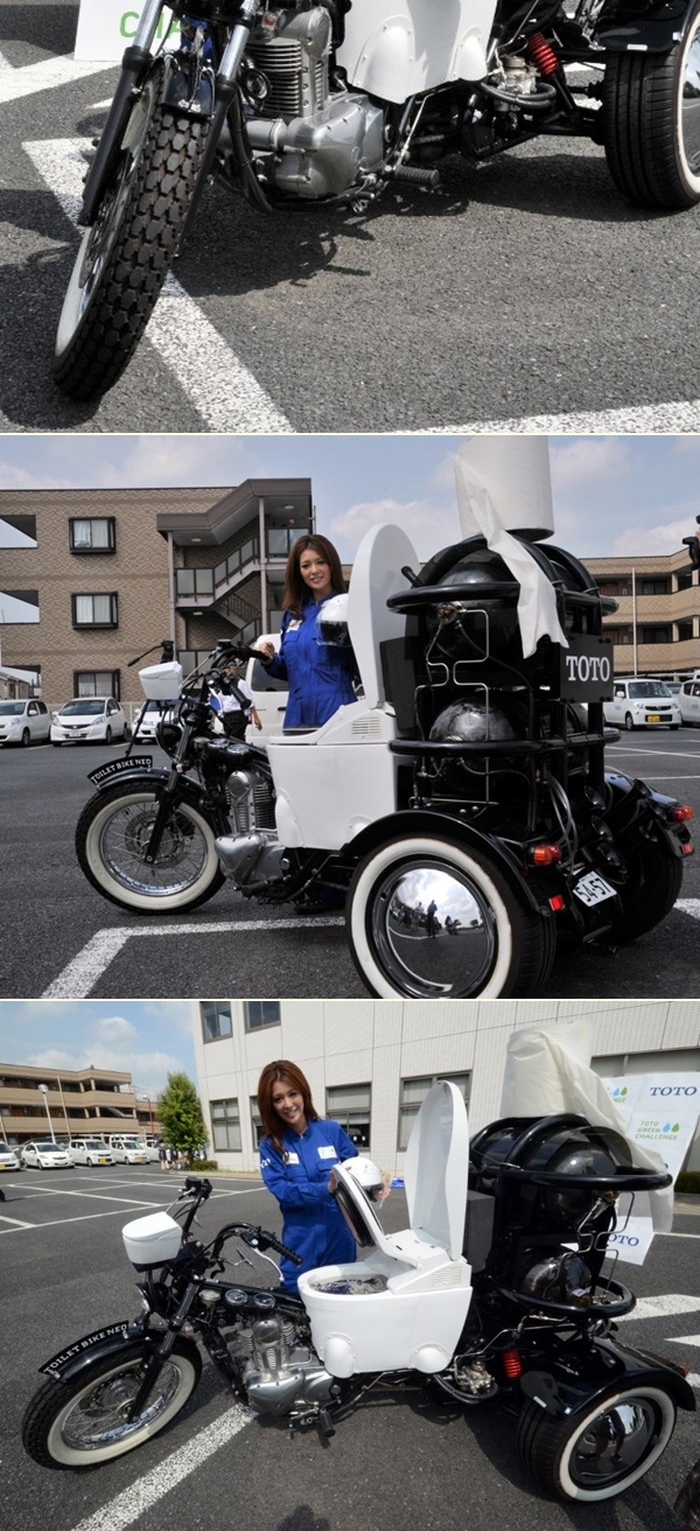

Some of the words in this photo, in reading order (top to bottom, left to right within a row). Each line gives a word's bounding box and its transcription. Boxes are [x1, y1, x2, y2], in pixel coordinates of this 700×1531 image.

[566, 655, 610, 682] TOTO
[90, 765, 115, 784] TOILET
[116, 759, 134, 769] BIKE
[650, 1086, 697, 1096] TOTO
[608, 1233, 640, 1247] OTO
[43, 1345, 80, 1376] TOILET
[81, 1332, 106, 1349] BIKE
[106, 1324, 127, 1336] NEO
